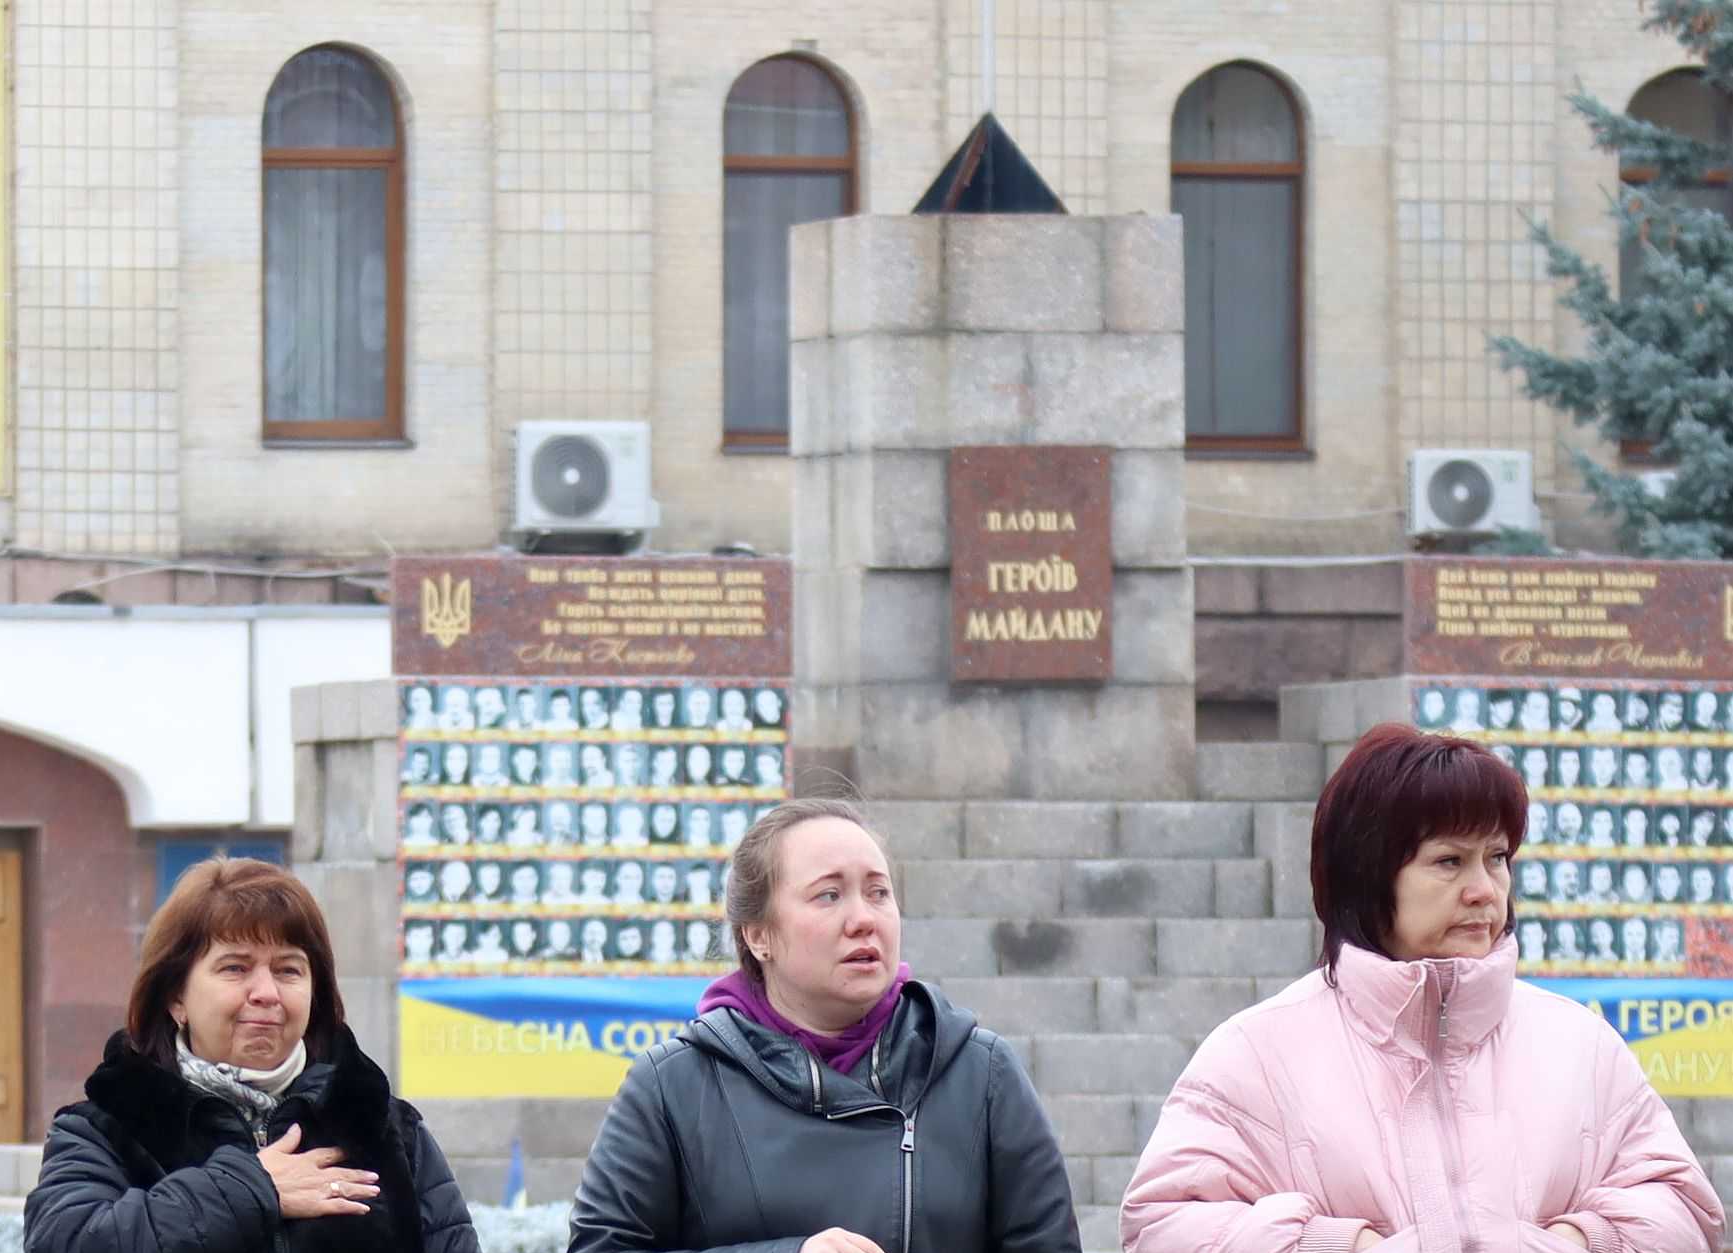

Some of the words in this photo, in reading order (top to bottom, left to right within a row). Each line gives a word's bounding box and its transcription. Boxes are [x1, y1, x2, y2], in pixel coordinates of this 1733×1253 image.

[988, 554, 1079, 593] ГЕРОЇВ
[965, 606, 1103, 641] МАЙДАНУ
[422, 1020, 592, 1054] НЕБЕСНА
[602, 1020, 689, 1053] СОТ
